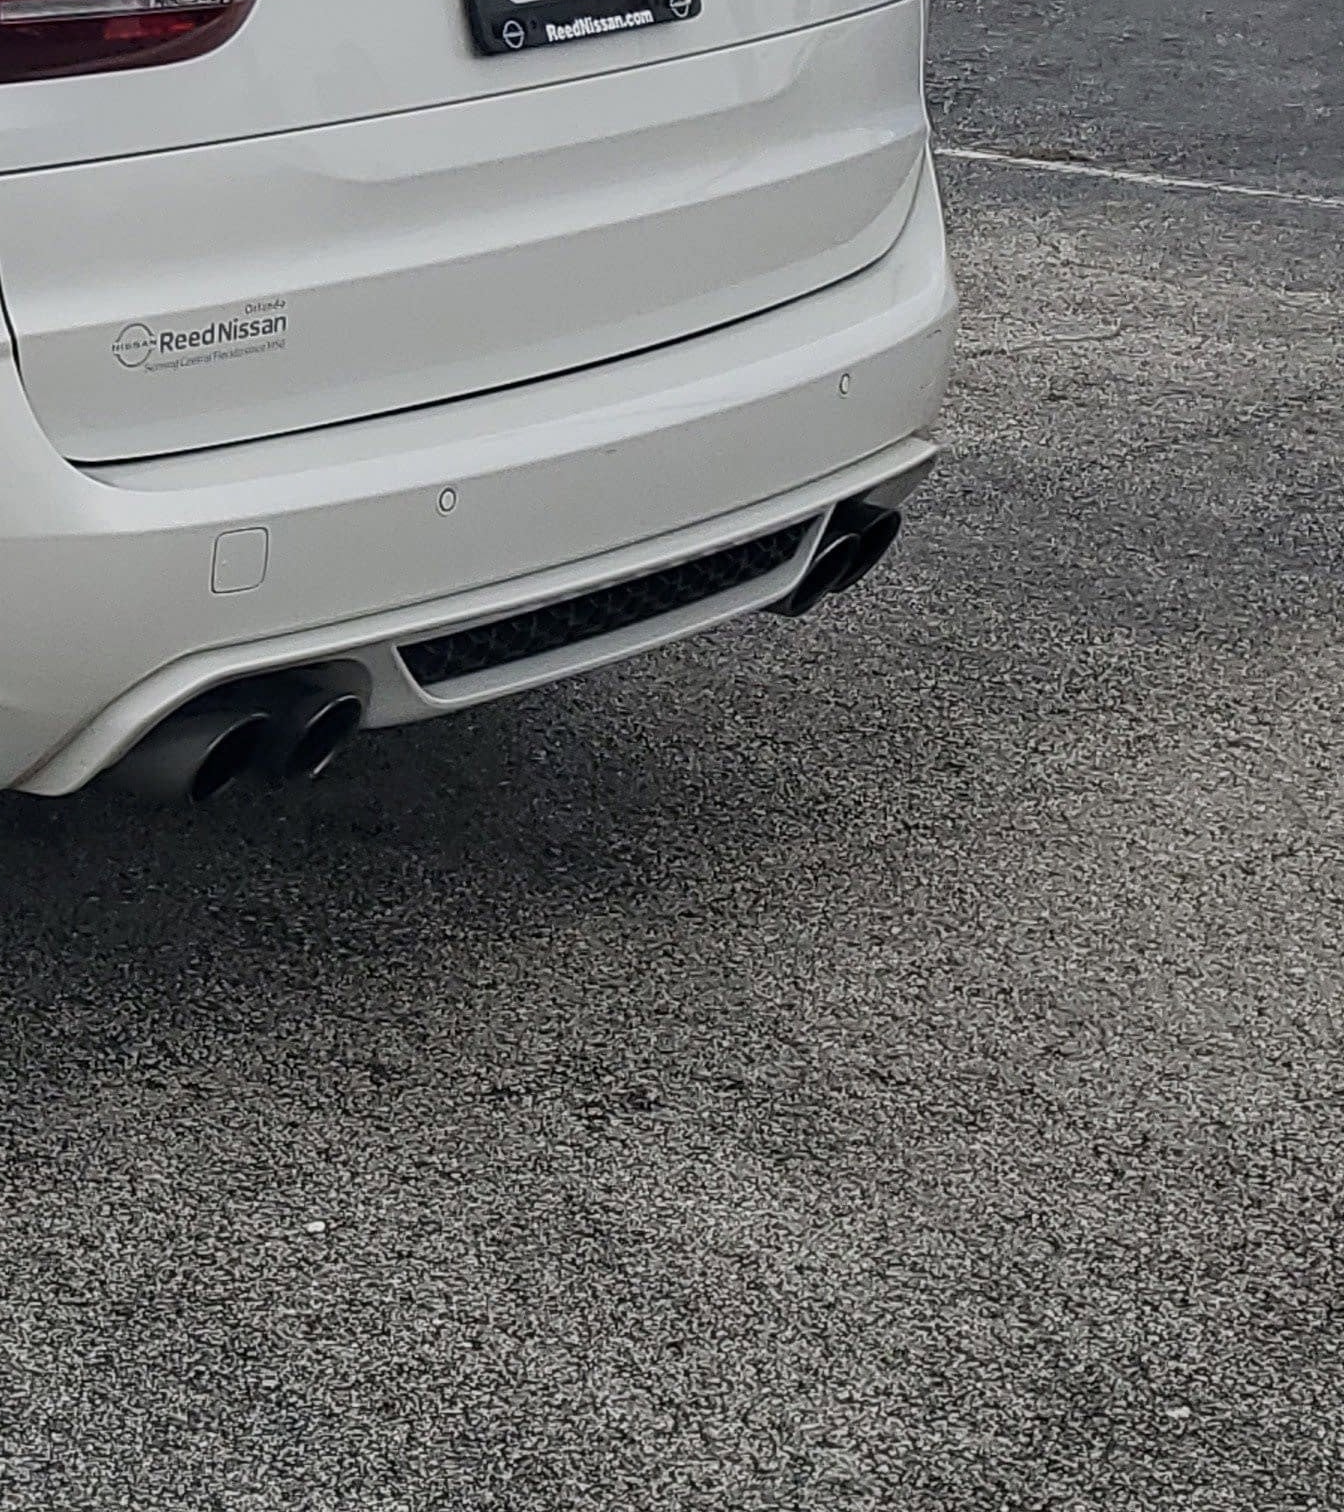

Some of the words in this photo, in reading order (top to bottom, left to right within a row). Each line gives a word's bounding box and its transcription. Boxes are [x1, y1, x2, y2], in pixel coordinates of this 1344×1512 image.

[546, 9, 654, 43] ReedNissan.com
[160, 323, 215, 354] Reed
[218, 316, 287, 344] Nissan
